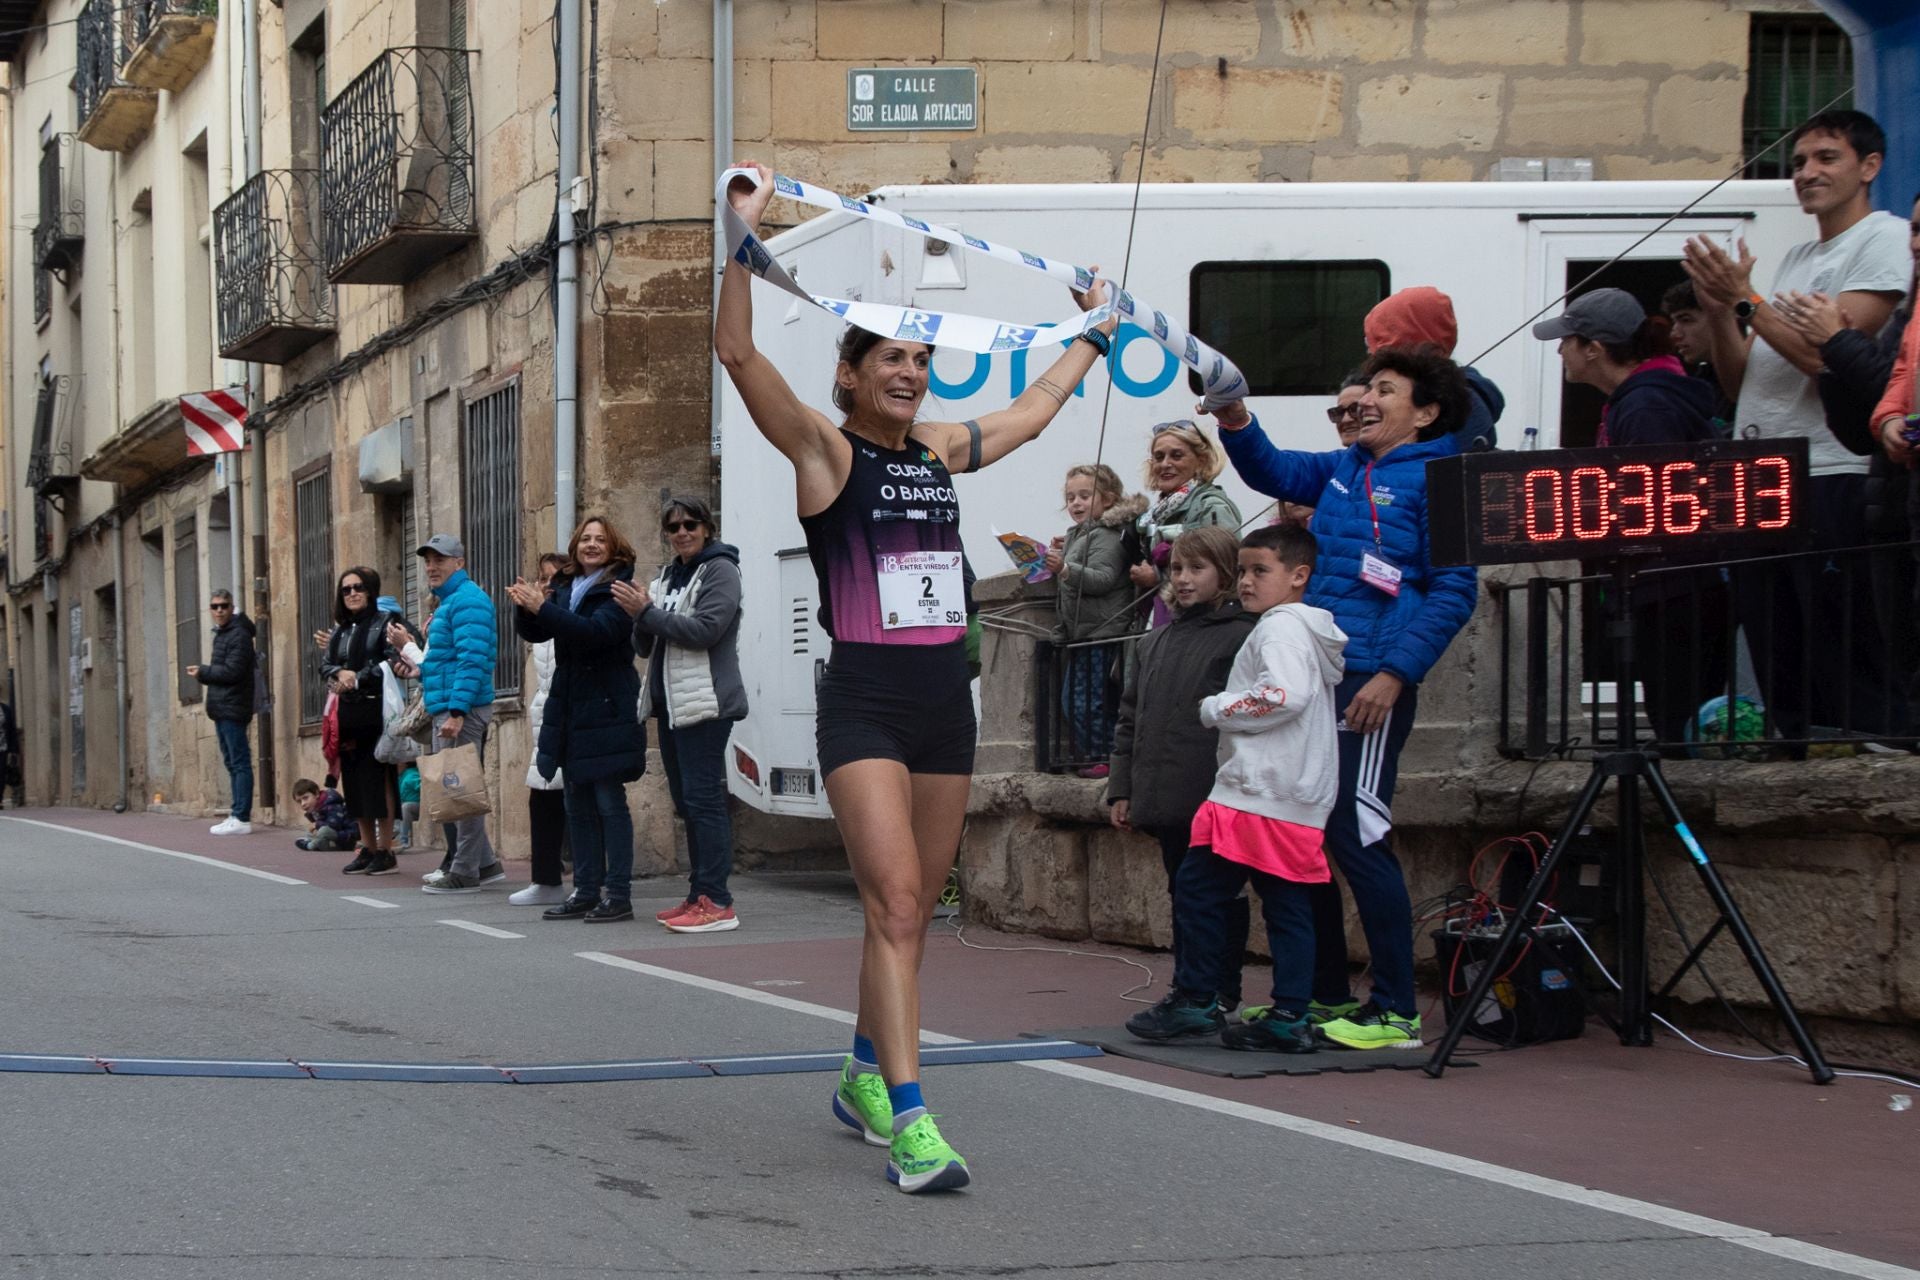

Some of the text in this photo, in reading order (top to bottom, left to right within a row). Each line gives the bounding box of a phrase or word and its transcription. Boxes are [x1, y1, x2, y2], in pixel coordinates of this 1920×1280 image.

[894, 78, 936, 92] CALLE
[852, 103, 973, 122] SOR ELADIA ARTACHO
[903, 310, 936, 336] R
[998, 324, 1034, 344] R
[886, 463, 932, 477] CUPA
[880, 484, 957, 503] O BARCO
[1524, 457, 1791, 542] 00:36:13
[881, 555, 898, 573] 18
[899, 563, 950, 571] ENTRE VIÑEDOS
[921, 575, 934, 598] 2
[918, 599, 940, 607] ESTHER
